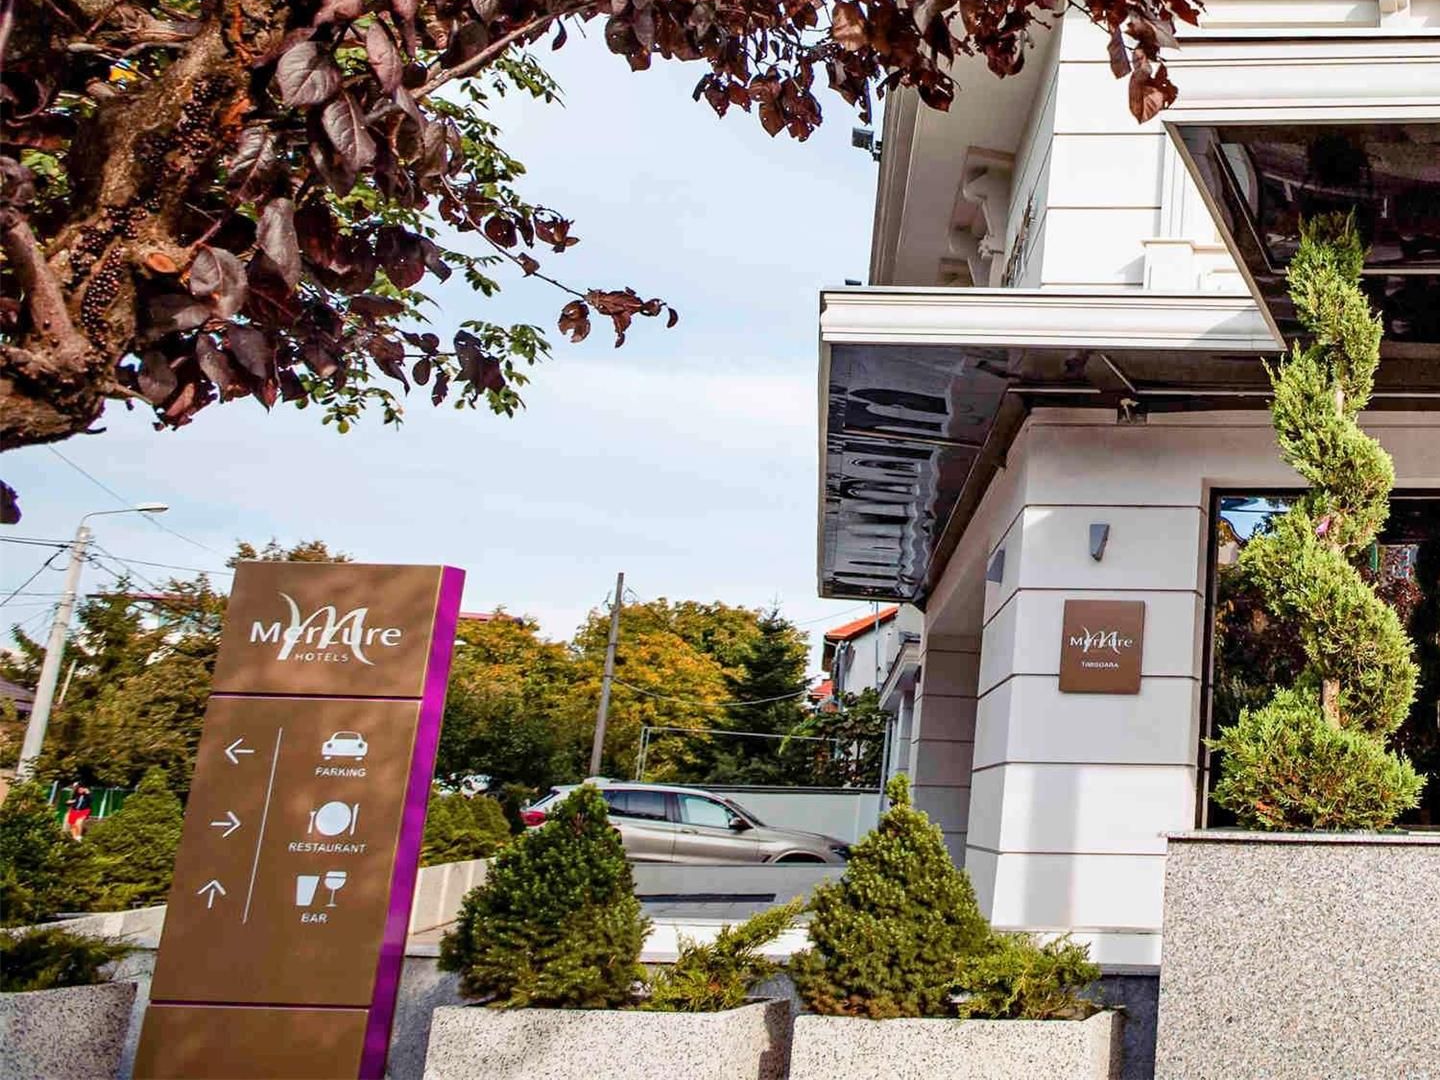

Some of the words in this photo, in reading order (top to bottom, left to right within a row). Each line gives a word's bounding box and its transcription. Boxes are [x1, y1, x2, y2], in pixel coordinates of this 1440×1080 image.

[294, 652, 350, 663] HOTELS
[314, 766, 367, 778] PARKING
[288, 841, 367, 854] RESTAURANT
[301, 912, 328, 924] BAR
